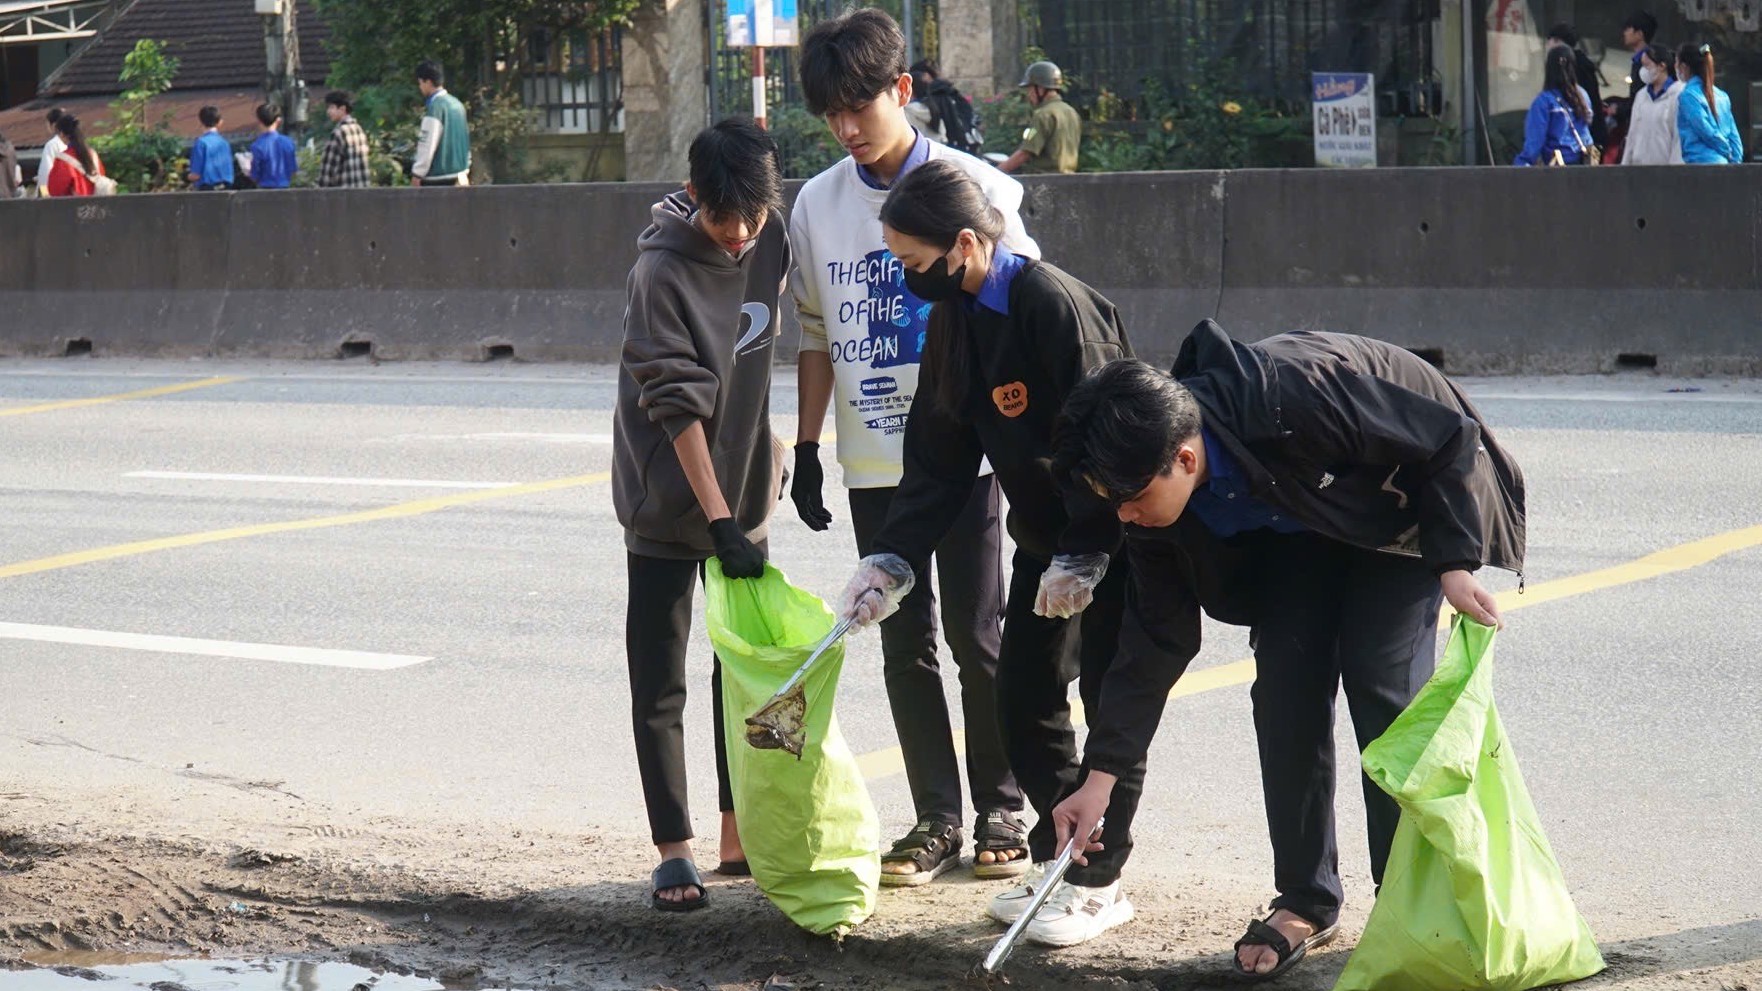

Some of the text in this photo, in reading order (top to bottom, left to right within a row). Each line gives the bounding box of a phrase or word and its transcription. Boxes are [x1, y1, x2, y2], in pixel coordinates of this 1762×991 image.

[830, 334, 898, 363] OCEAN
[859, 398, 883, 406] MYSTERY
[876, 416, 901, 427] YEARN
